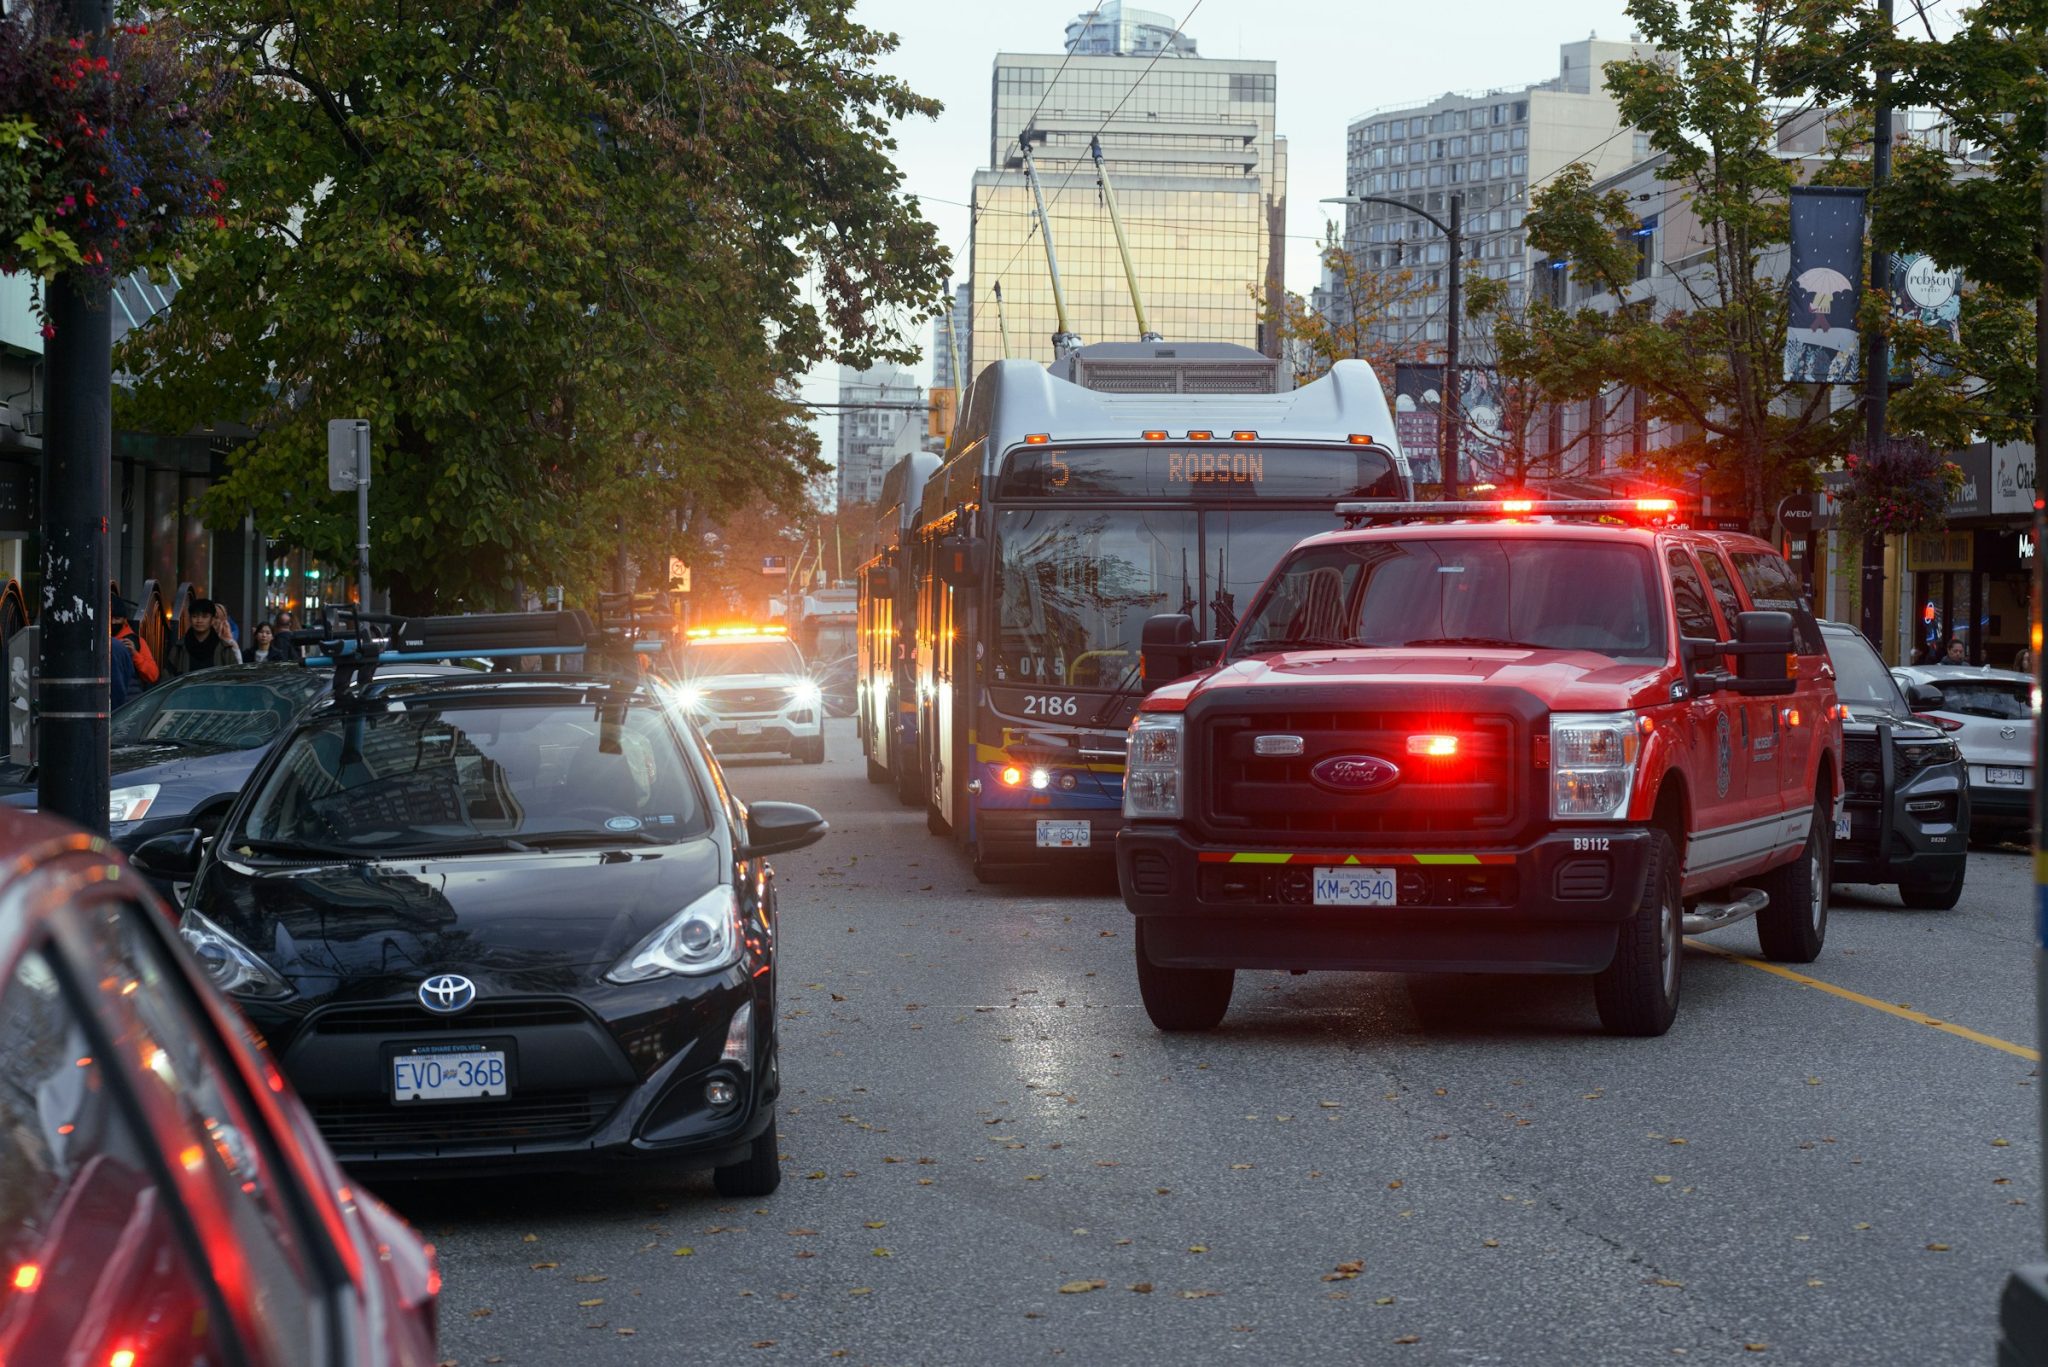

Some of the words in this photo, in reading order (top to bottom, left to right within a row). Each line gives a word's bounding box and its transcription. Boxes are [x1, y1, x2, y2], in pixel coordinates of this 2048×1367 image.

[1910, 267, 1952, 288] robson
[1051, 450, 1069, 488] 5
[1169, 453, 1263, 483] ROBSON
[1024, 696, 1078, 716] 2186
[1330, 761, 1377, 782] Ford
[1060, 827, 1088, 841] 8575
[1574, 838, 1609, 852] B9112
[1317, 879, 1339, 899] KM
[1349, 879, 1393, 900] 3540
[396, 1062, 442, 1090] EVO
[458, 1059, 504, 1087] 36B
